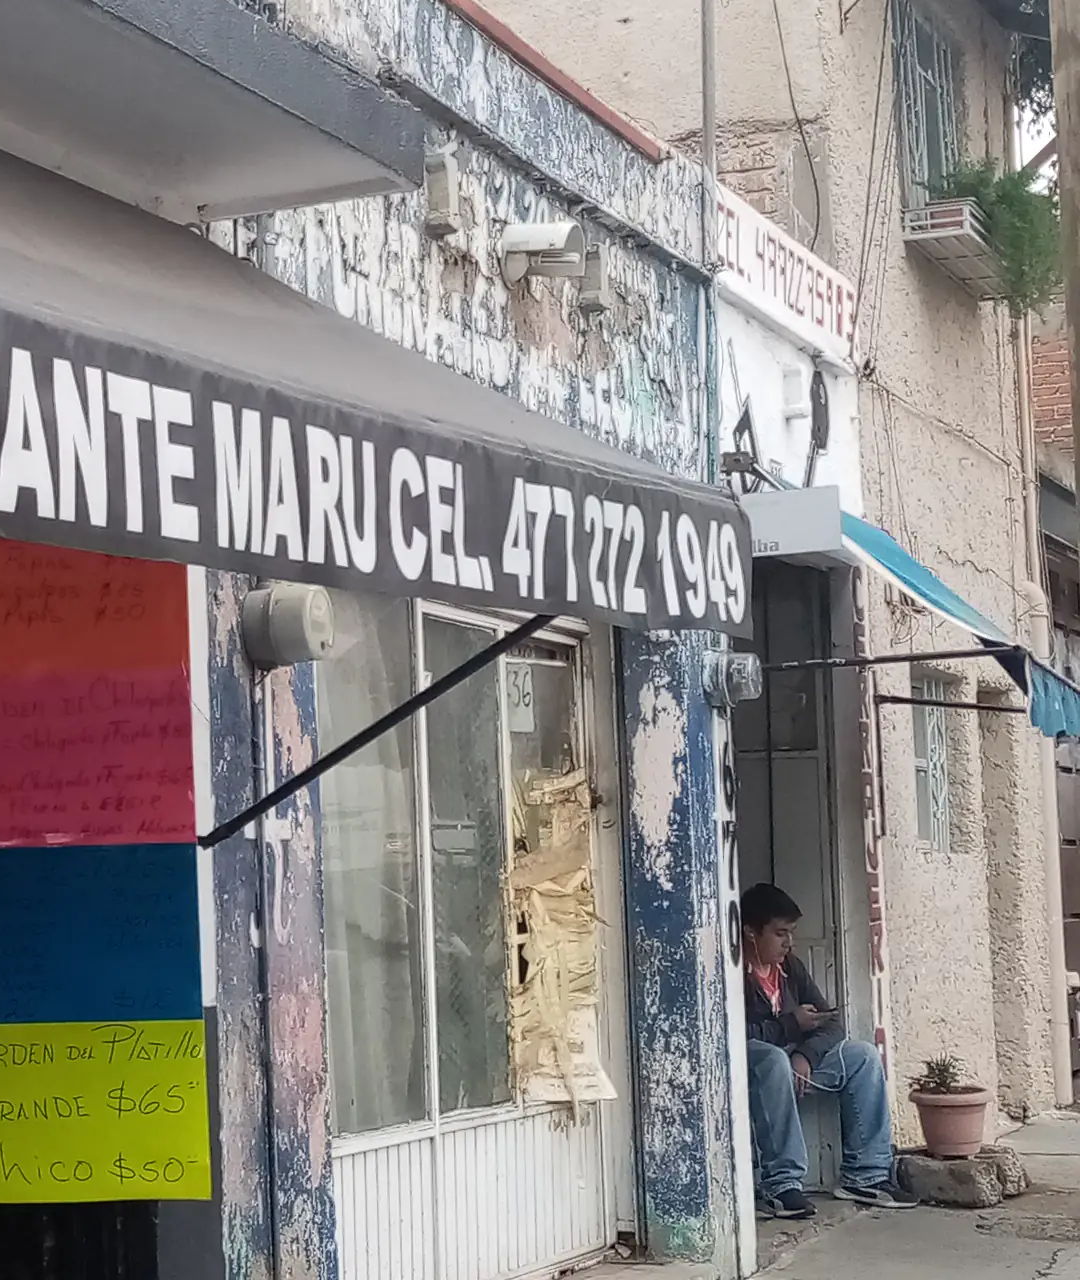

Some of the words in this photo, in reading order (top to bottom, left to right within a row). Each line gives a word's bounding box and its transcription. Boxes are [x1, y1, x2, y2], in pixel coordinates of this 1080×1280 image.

[212, 400, 377, 575] MARU
[389, 447, 493, 592] CEL.
[502, 476, 577, 603] 477
[583, 494, 647, 615] 272
[657, 510, 745, 625] 1949
